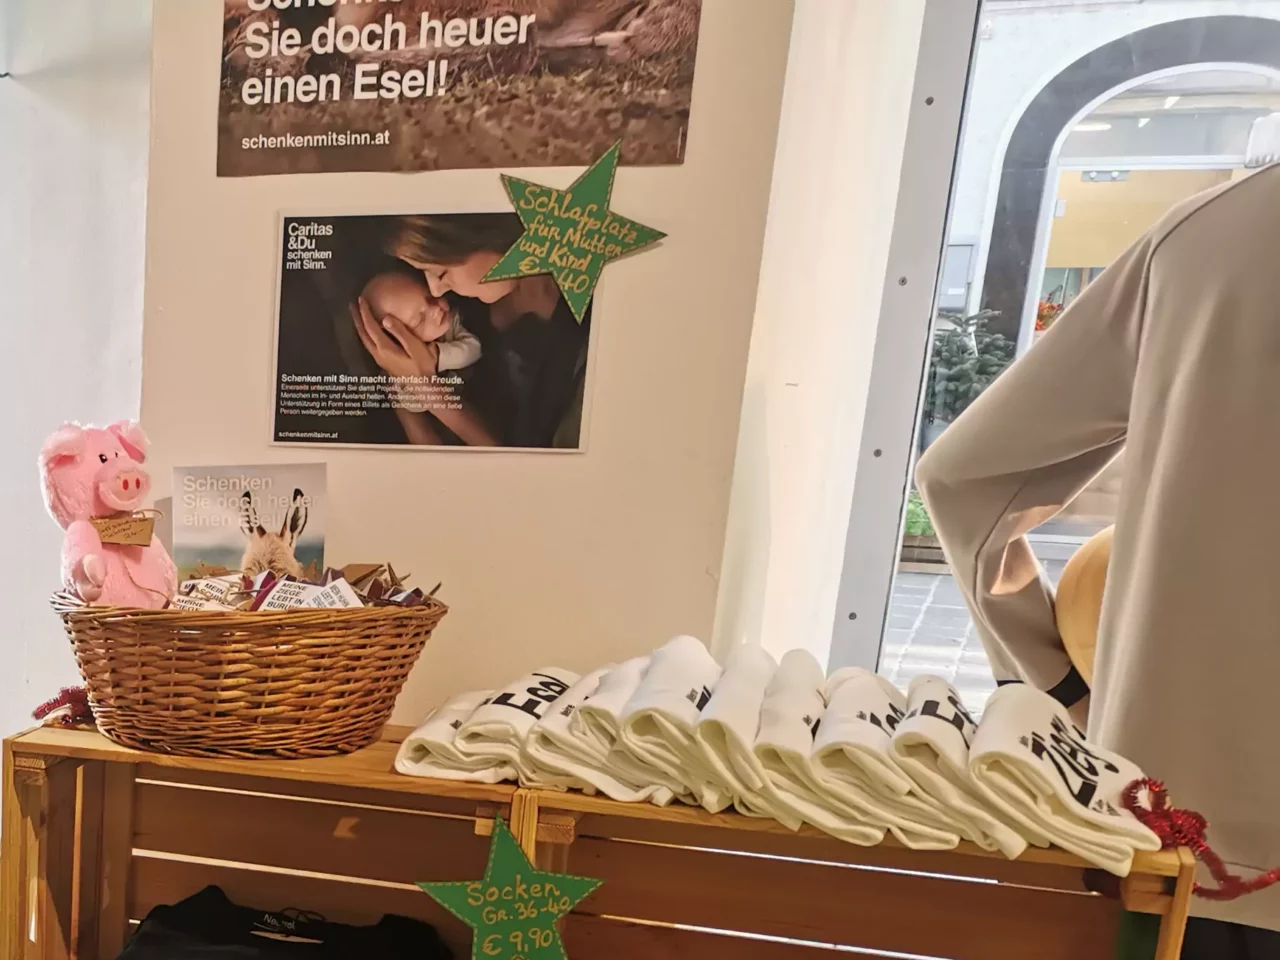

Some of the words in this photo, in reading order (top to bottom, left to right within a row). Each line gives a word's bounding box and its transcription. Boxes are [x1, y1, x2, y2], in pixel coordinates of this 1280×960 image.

[244, 20, 301, 59] Sie
[311, 13, 406, 54] doch
[419, 11, 536, 49] heuer
[241, 68, 341, 105] einen
[353, 59, 449, 100] Esel!
[241, 129, 390, 150] schenkenmitsinn.at
[520, 186, 637, 243] Schlafplatz
[288, 222, 333, 236] Caritas
[529, 215, 561, 240] für
[562, 229, 622, 256] Mutter
[288, 236, 316, 249] &Du
[287, 249, 332, 260] schenken
[520, 238, 549, 258] und
[548, 245, 592, 272] Kind
[286, 260, 301, 270] mit
[303, 259, 327, 270] Sinn.
[556, 269, 589, 293] 40
[281, 374, 322, 383] Schenken
[324, 374, 337, 383] mit
[339, 374, 358, 383] Sinn
[360, 375, 386, 384] macht
[388, 375, 429, 384] mehrfach
[431, 375, 464, 385] Freude.
[278, 431, 338, 439] schenkenmitsinn.at
[183, 475, 272, 491] Schenken
[183, 493, 210, 509] Sie
[218, 494, 261, 509] doch
[268, 494, 318, 508] heuer
[184, 511, 232, 527] einen
[276, 588, 301, 597] ZIEGE
[282, 582, 308, 591] MEINE
[271, 594, 293, 603] LEBT
[467, 874, 560, 906] Socken
